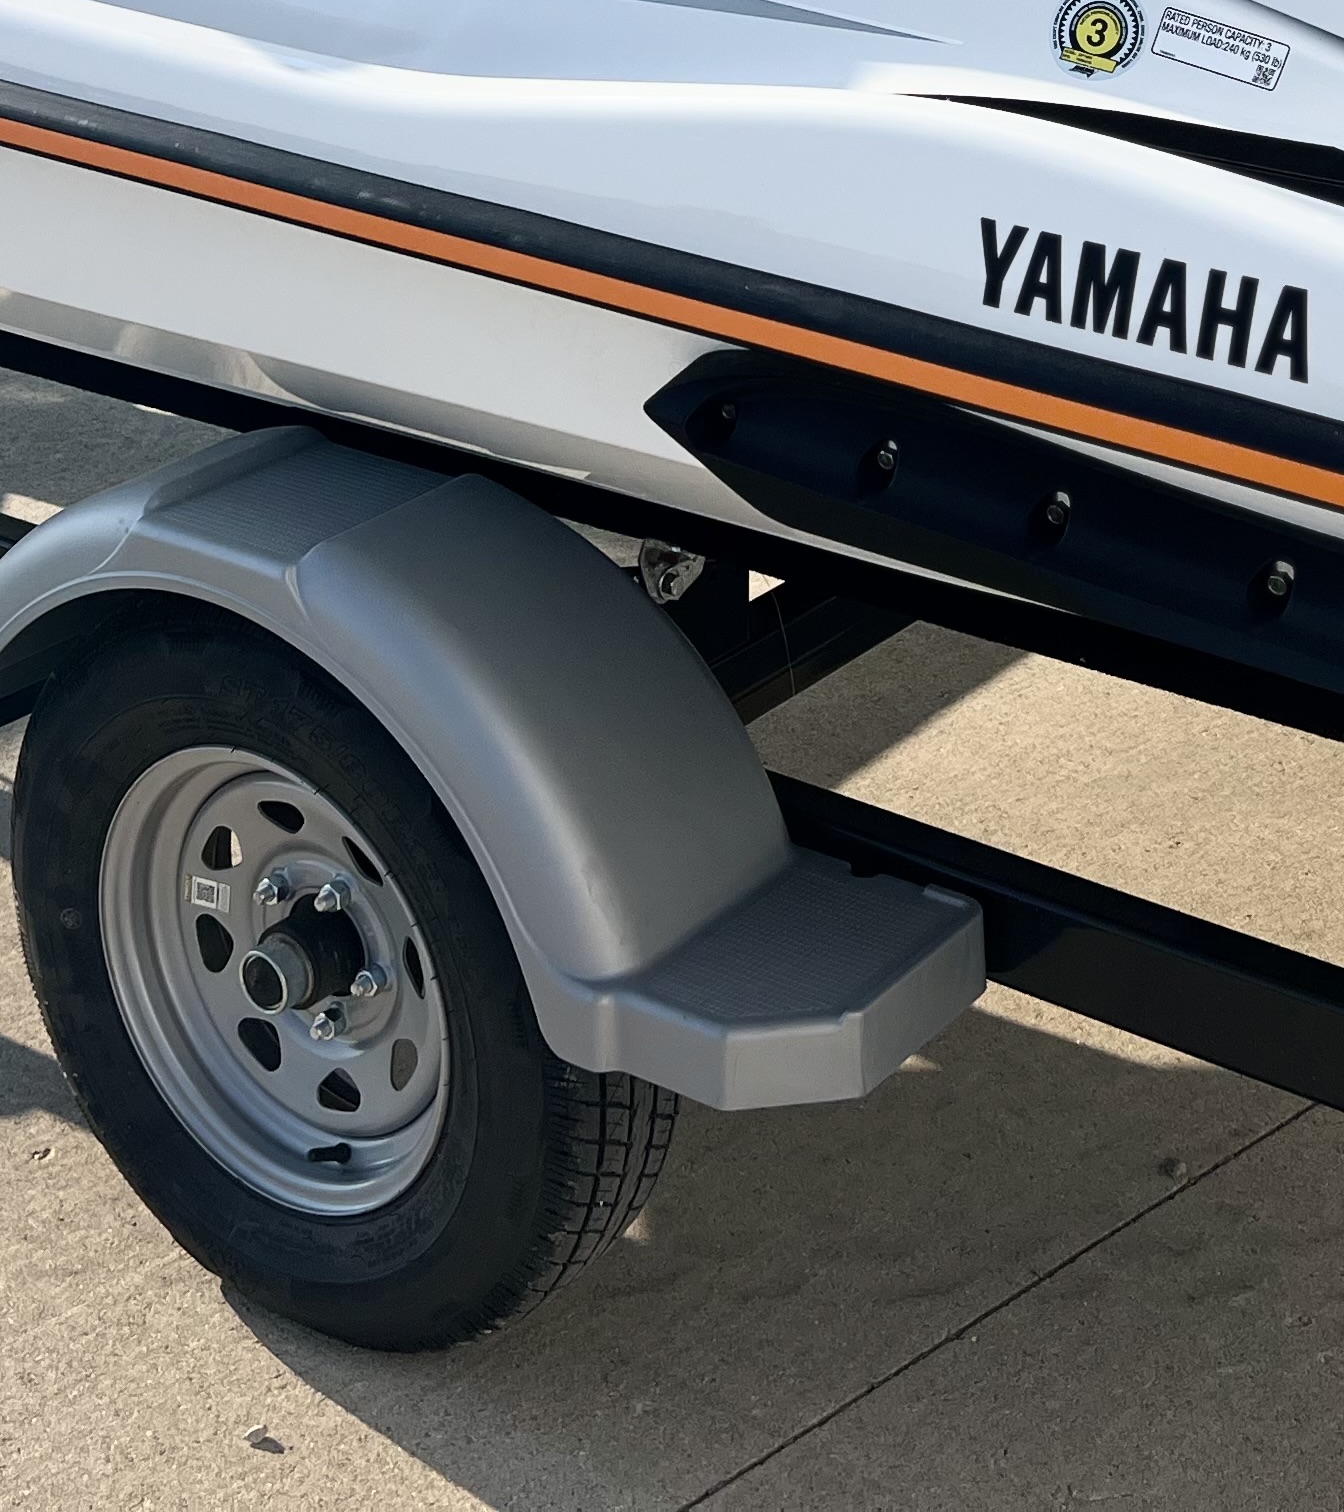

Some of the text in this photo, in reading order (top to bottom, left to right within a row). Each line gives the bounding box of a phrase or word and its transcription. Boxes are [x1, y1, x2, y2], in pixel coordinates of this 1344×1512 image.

[1086, 17, 1108, 48] 3
[1161, 21, 1201, 41] MAXIMUM
[1164, 10, 1190, 26] RATED
[1191, 18, 1225, 37] PERSON
[1264, 42, 1273, 52] 3
[980, 216, 1309, 384] YAMAHA
